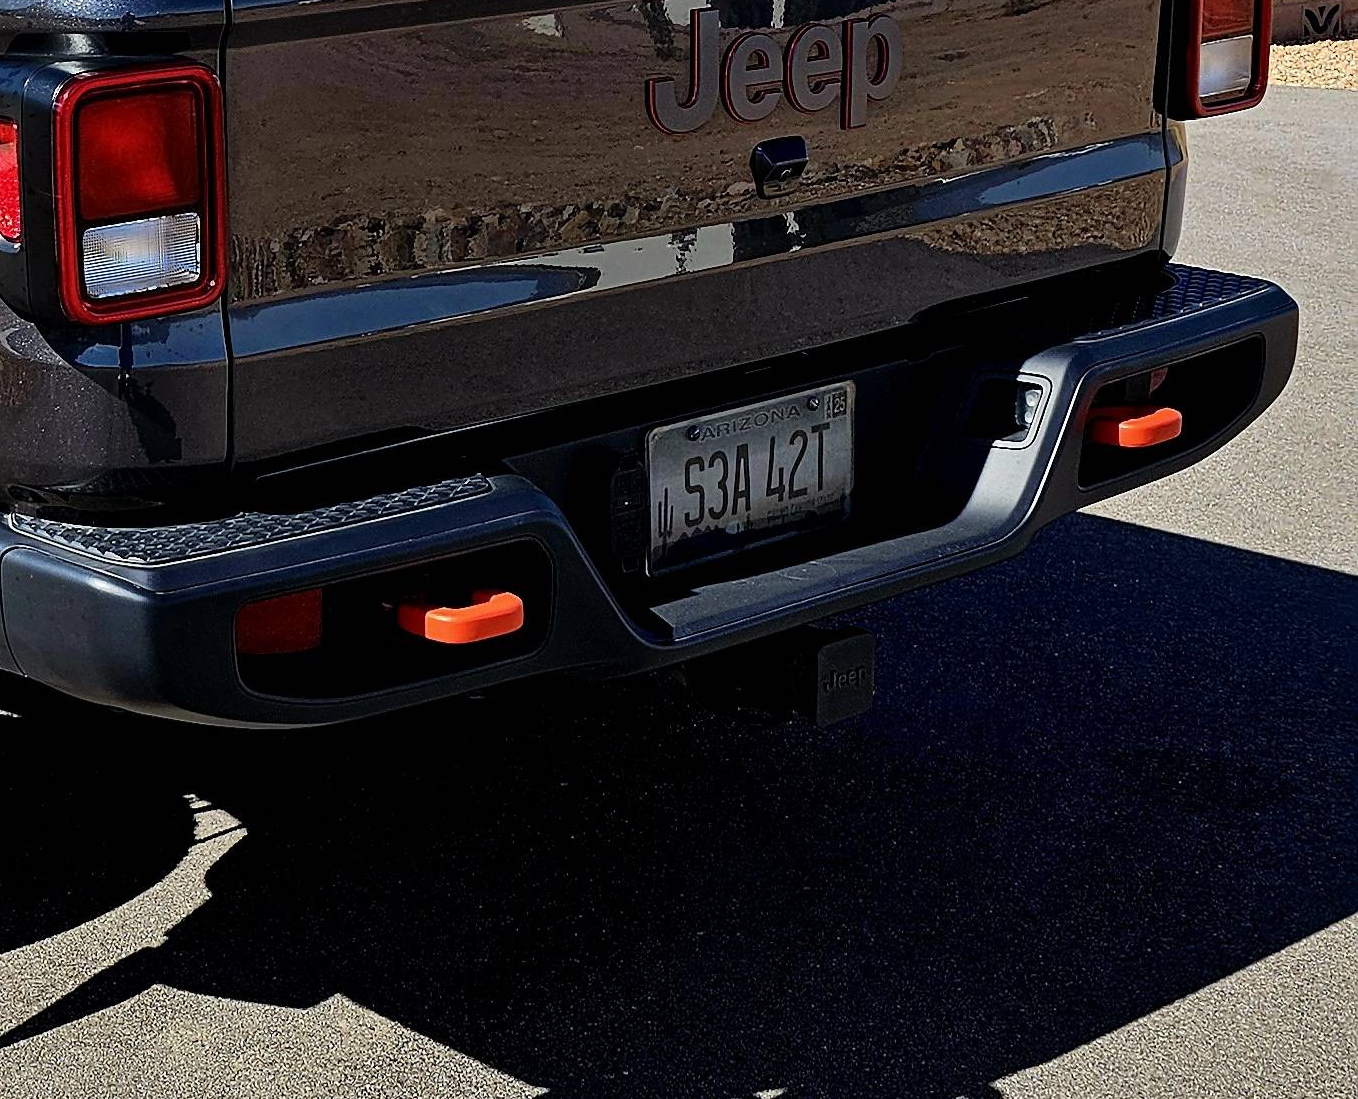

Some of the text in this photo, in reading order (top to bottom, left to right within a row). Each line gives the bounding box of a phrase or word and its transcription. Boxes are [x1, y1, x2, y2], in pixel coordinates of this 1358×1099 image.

[645, 5, 903, 135] Jeep
[684, 421, 831, 528] S3A 42T
[700, 405, 801, 442] ARIZONA
